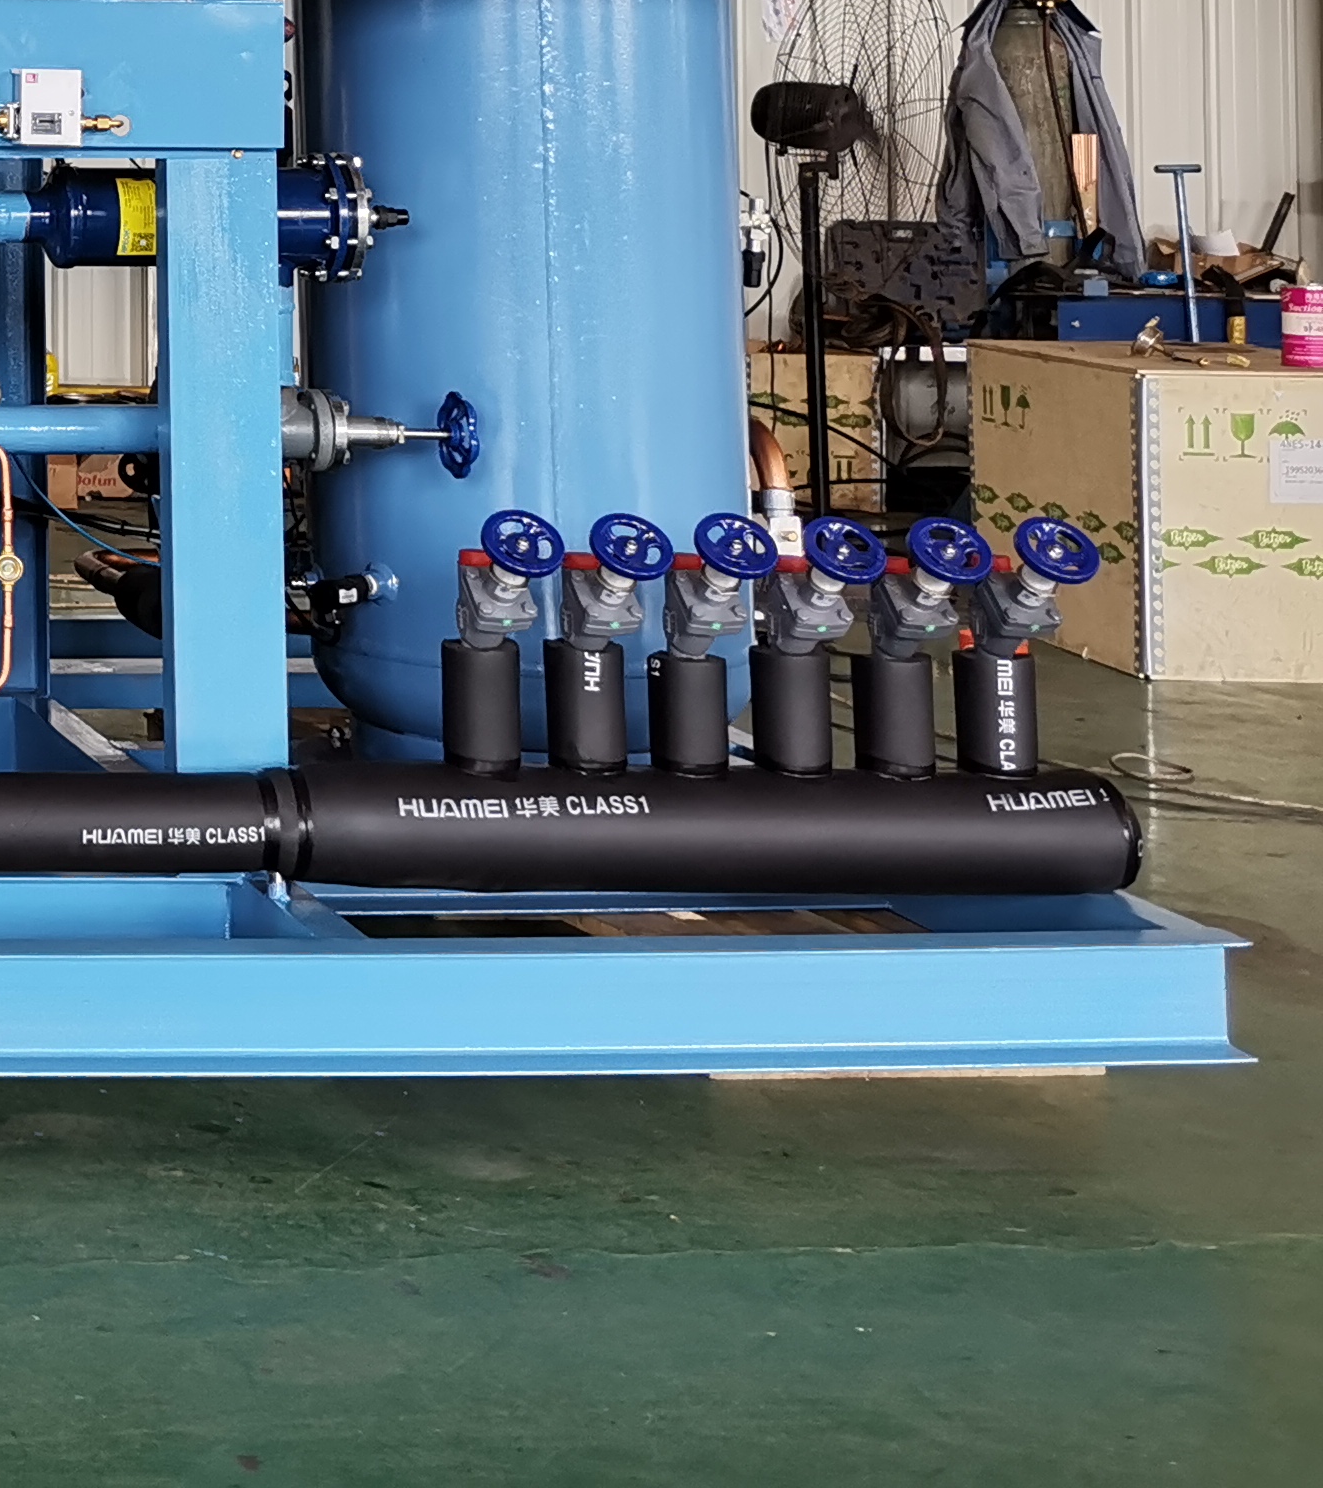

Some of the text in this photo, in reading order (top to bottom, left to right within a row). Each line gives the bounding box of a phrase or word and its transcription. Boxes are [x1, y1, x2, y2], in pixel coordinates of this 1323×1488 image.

[1170, 529, 1205, 546] Bitzer
[1257, 531, 1293, 548] Bitzer
[1214, 557, 1249, 574] Bitzer
[998, 699, 1016, 734] 华美
[397, 795, 650, 818] HUAMEI 华美 CLASS1
[986, 789, 1097, 812] HUAMEI
[82, 825, 266, 845] HUAMEI 华美 CLASS1
